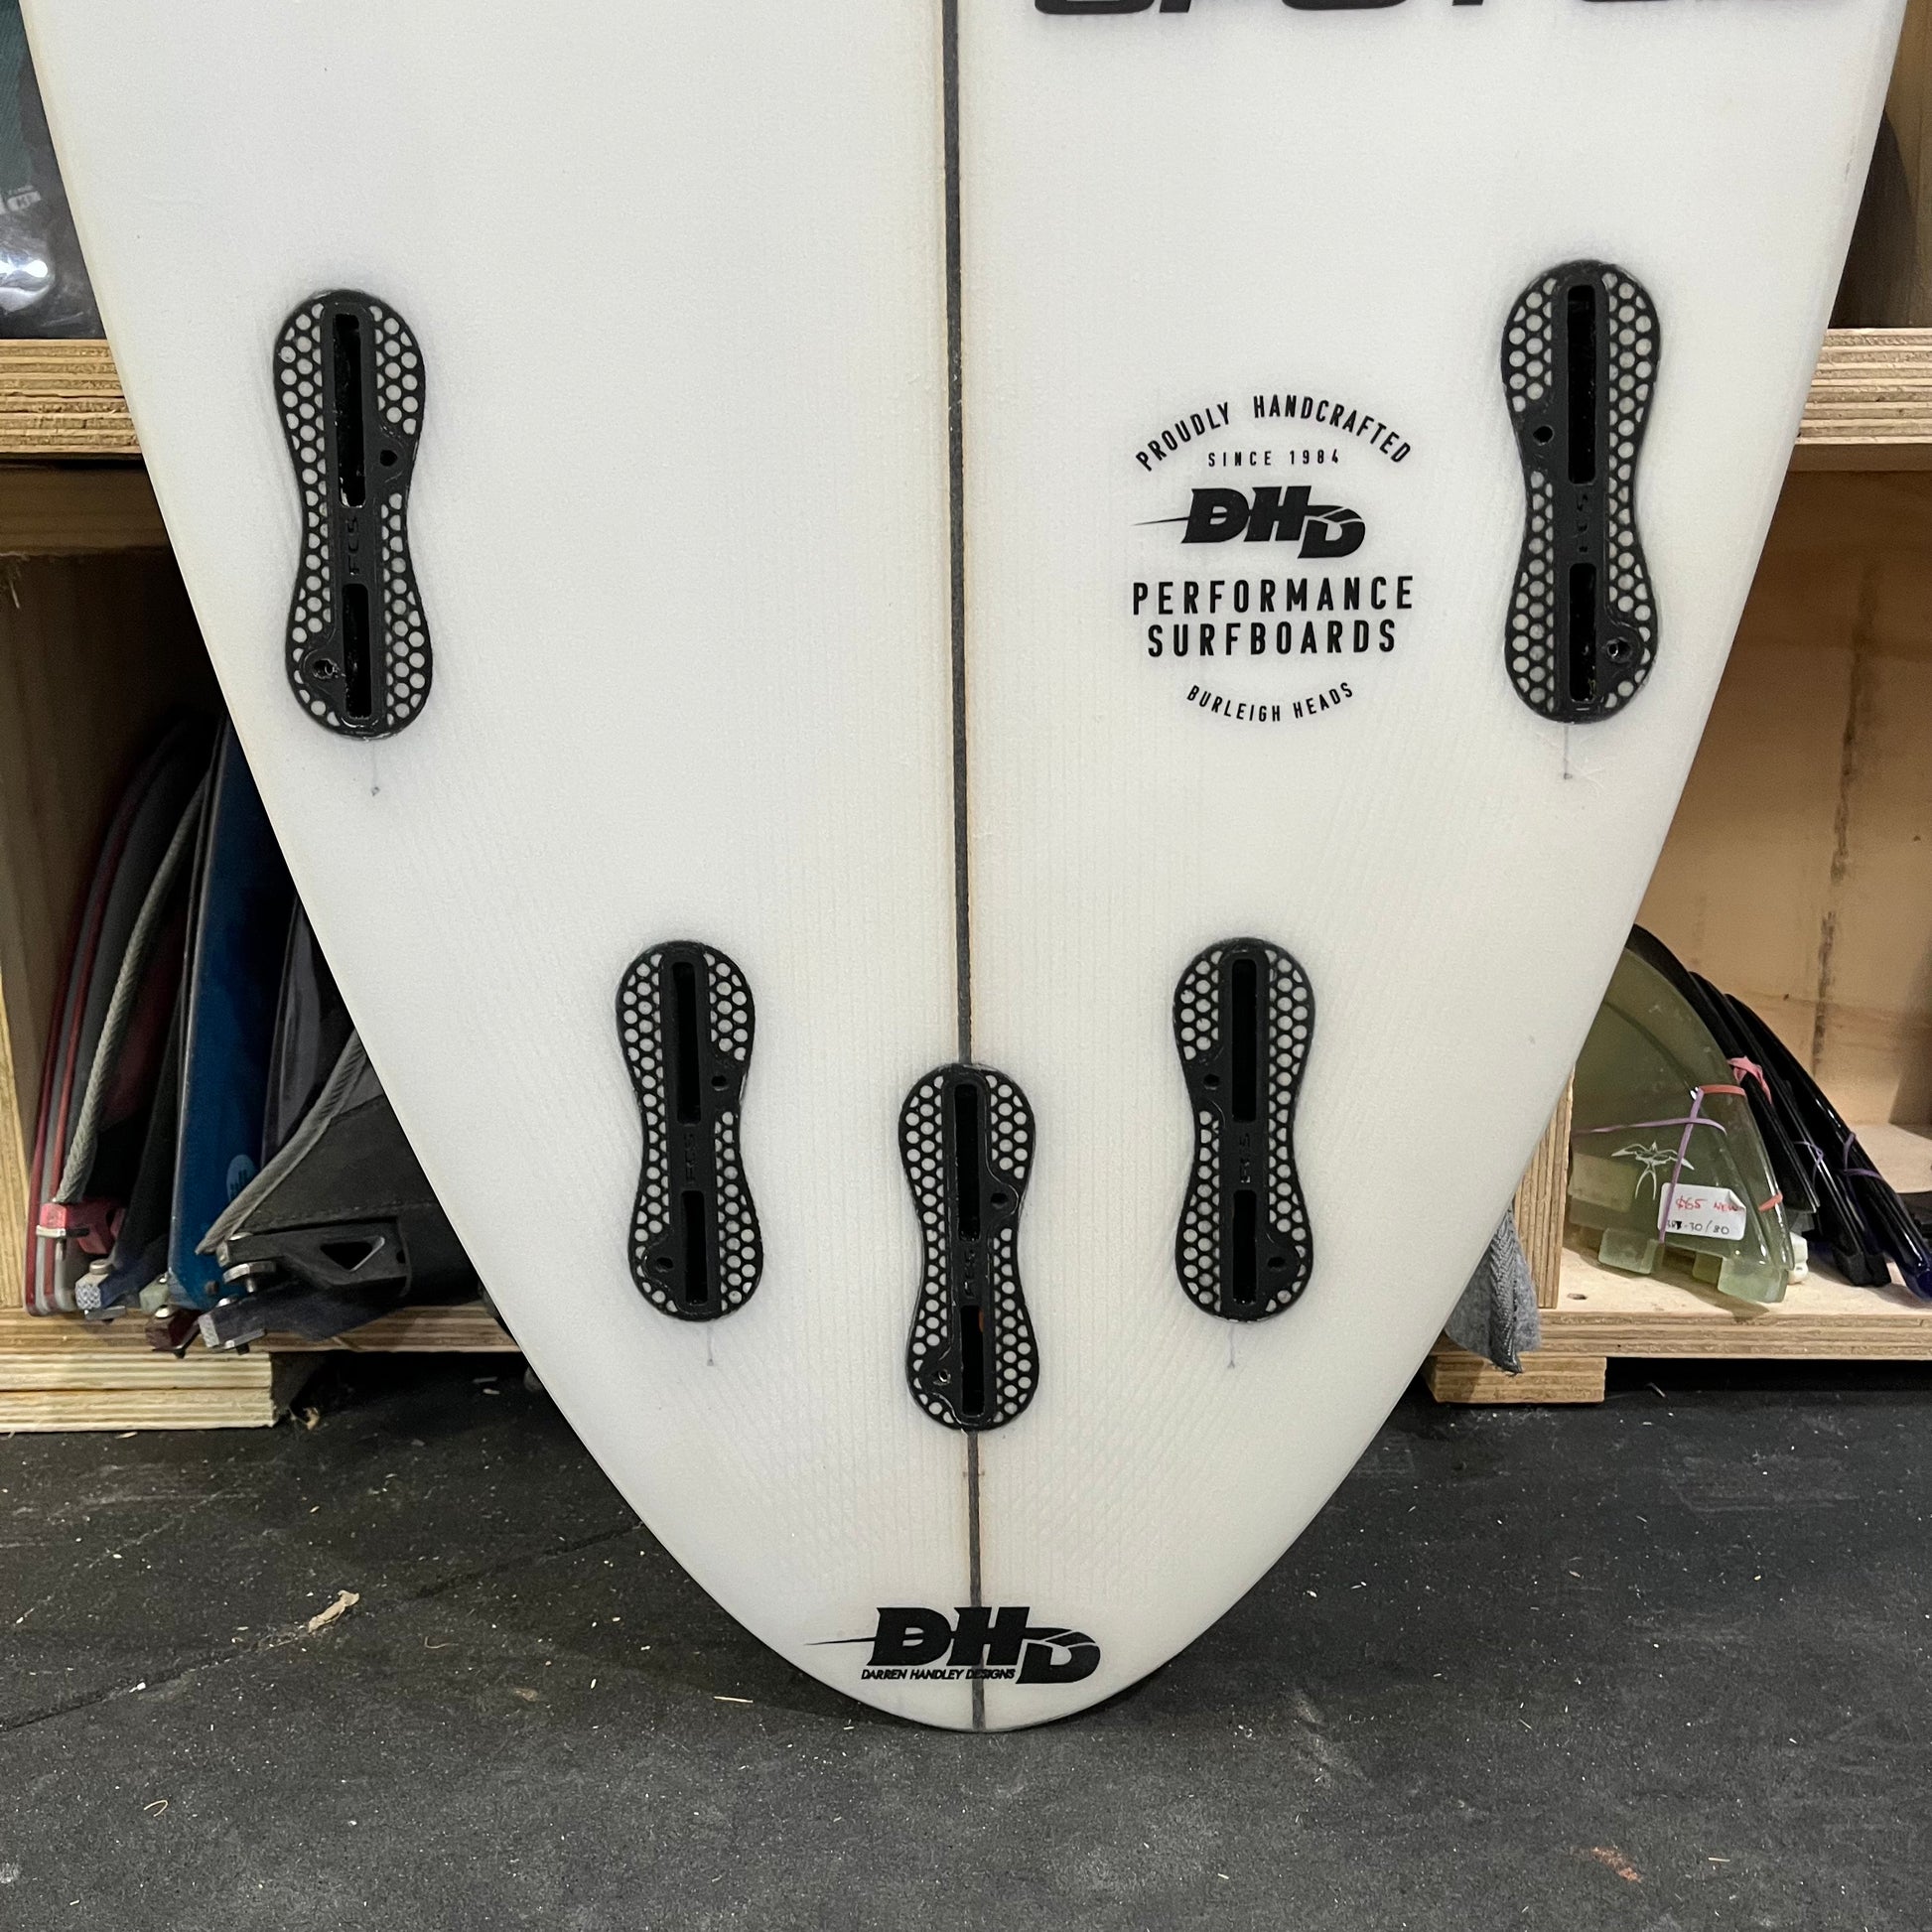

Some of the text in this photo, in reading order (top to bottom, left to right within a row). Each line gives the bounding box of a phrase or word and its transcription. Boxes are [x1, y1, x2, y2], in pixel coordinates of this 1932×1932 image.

[1135, 394, 1412, 473] PROUDLY HANDCRAFTED
[1207, 449, 1339, 467] SINCE 1984
[1180, 484, 1366, 559] DHD
[1132, 575, 1414, 616] PERFORMANCE
[1147, 619, 1396, 658] SURFBOARDS
[1186, 682, 1353, 722] BURLEIGH HEADS
[1675, 1194, 1708, 1211] $65
[866, 1606, 1101, 1684] DHD
[861, 1669, 1016, 1680] DARREN HANDLEY DESIGNS
